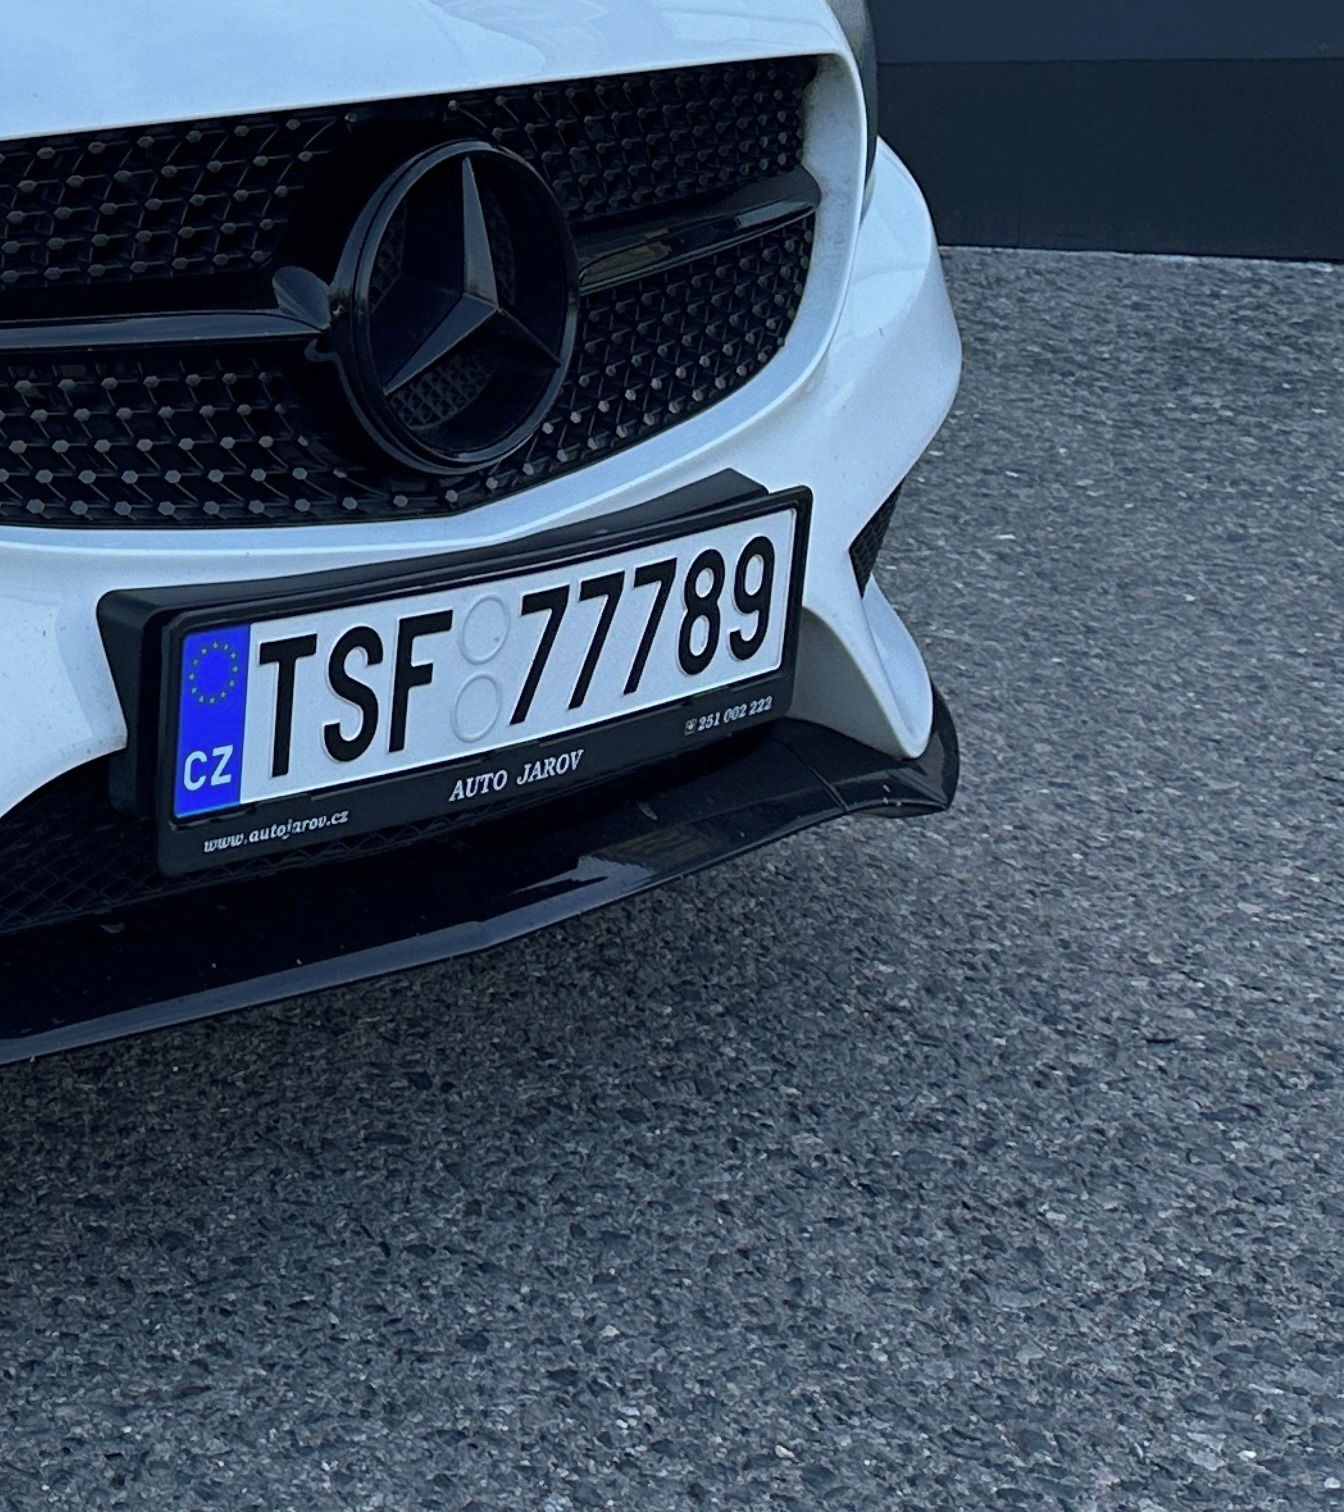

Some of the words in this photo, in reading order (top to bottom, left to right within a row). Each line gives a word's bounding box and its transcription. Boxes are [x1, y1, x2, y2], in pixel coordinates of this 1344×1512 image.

[259, 609, 453, 778] TSF
[510, 536, 775, 725] 77789
[723, 704, 747, 723] 002
[749, 696, 772, 715] 222
[184, 745, 233, 791] CZ
[448, 770, 508, 802] AUTO
[516, 749, 584, 785] JAROV
[204, 810, 349, 853] www.autojarov.cz
